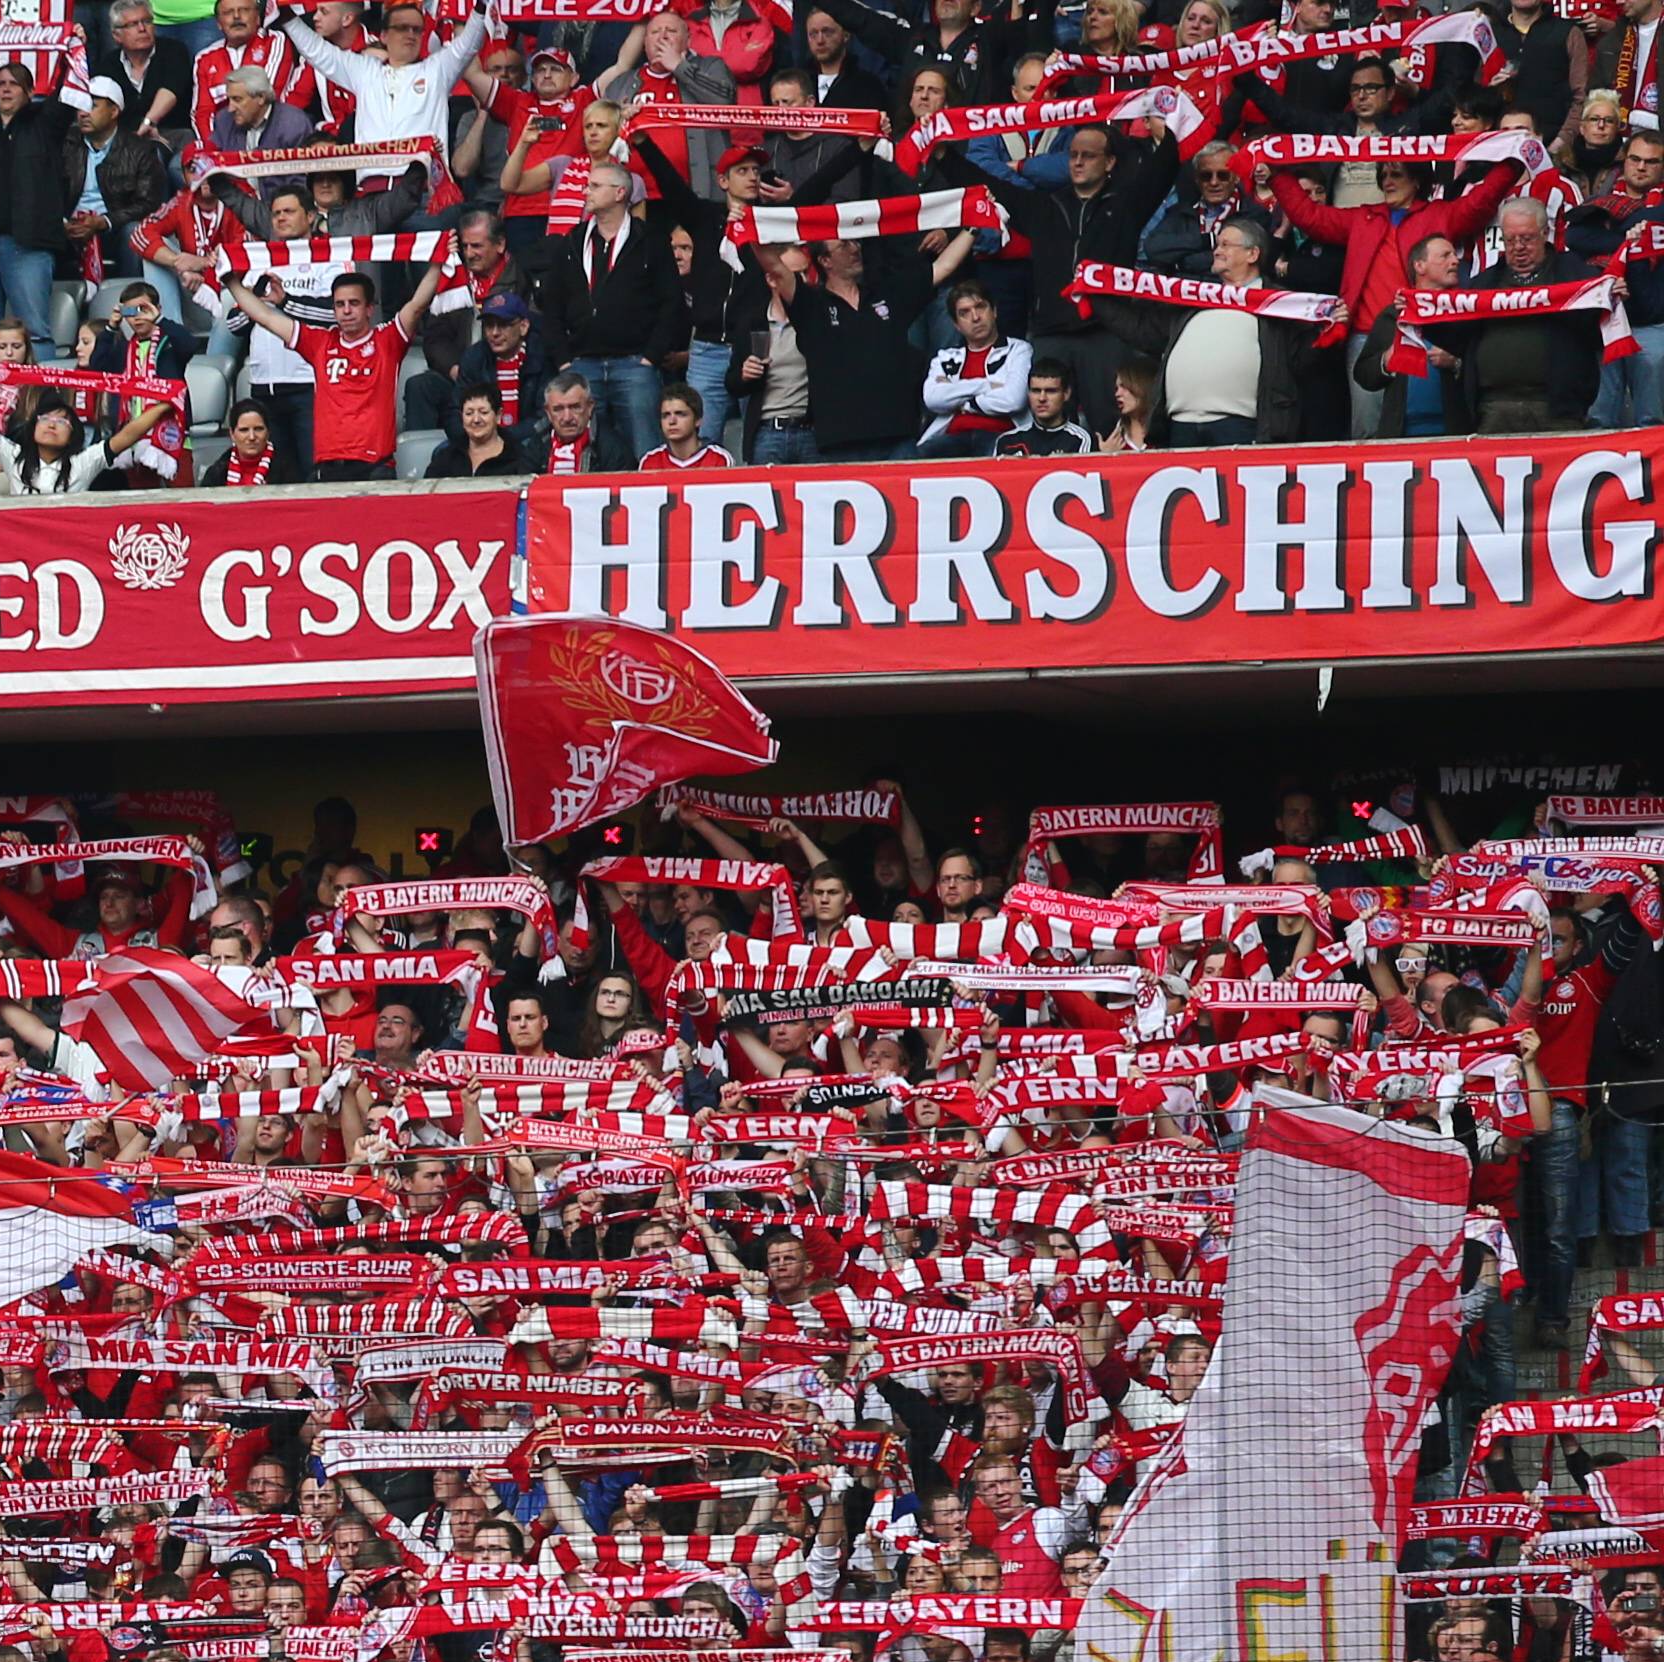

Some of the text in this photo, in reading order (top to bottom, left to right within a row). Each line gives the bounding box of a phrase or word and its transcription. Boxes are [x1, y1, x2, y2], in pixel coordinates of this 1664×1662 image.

[1231, 22, 1402, 62] BAYERN
[966, 97, 1097, 134] SAN MIA
[1292, 133, 1447, 160] BAYERN
[1116, 266, 1250, 306] BAYERN
[1415, 289, 1551, 317] SAN MIA
[562, 448, 1658, 632] HERRSCHING
[1041, 808, 1120, 832] BAYERN
[356, 880, 545, 912] FC BAYERN MÜNCHEN
[1421, 918, 1534, 942] FC BAYERN
[294, 955, 438, 984] SAN MIA
[1218, 981, 1301, 1002] BAYERN
[195, 1258, 414, 1279] FCB-SCHWERTE-RUHR
[453, 1265, 607, 1294] SAN MIA
[89, 1339, 312, 1370] MIA SAN MIA
[917, 1338, 1004, 1362] BAYERN
[531, 1374, 621, 1397] NUMBER
[1551, 1403, 1618, 1429] MIA
[564, 1423, 670, 1440] FC BAYERN
[11, 1479, 101, 1503] BAYERN
[1441, 1504, 1541, 1531] MEISTER
[888, 1599, 1062, 1625] BAYERN
